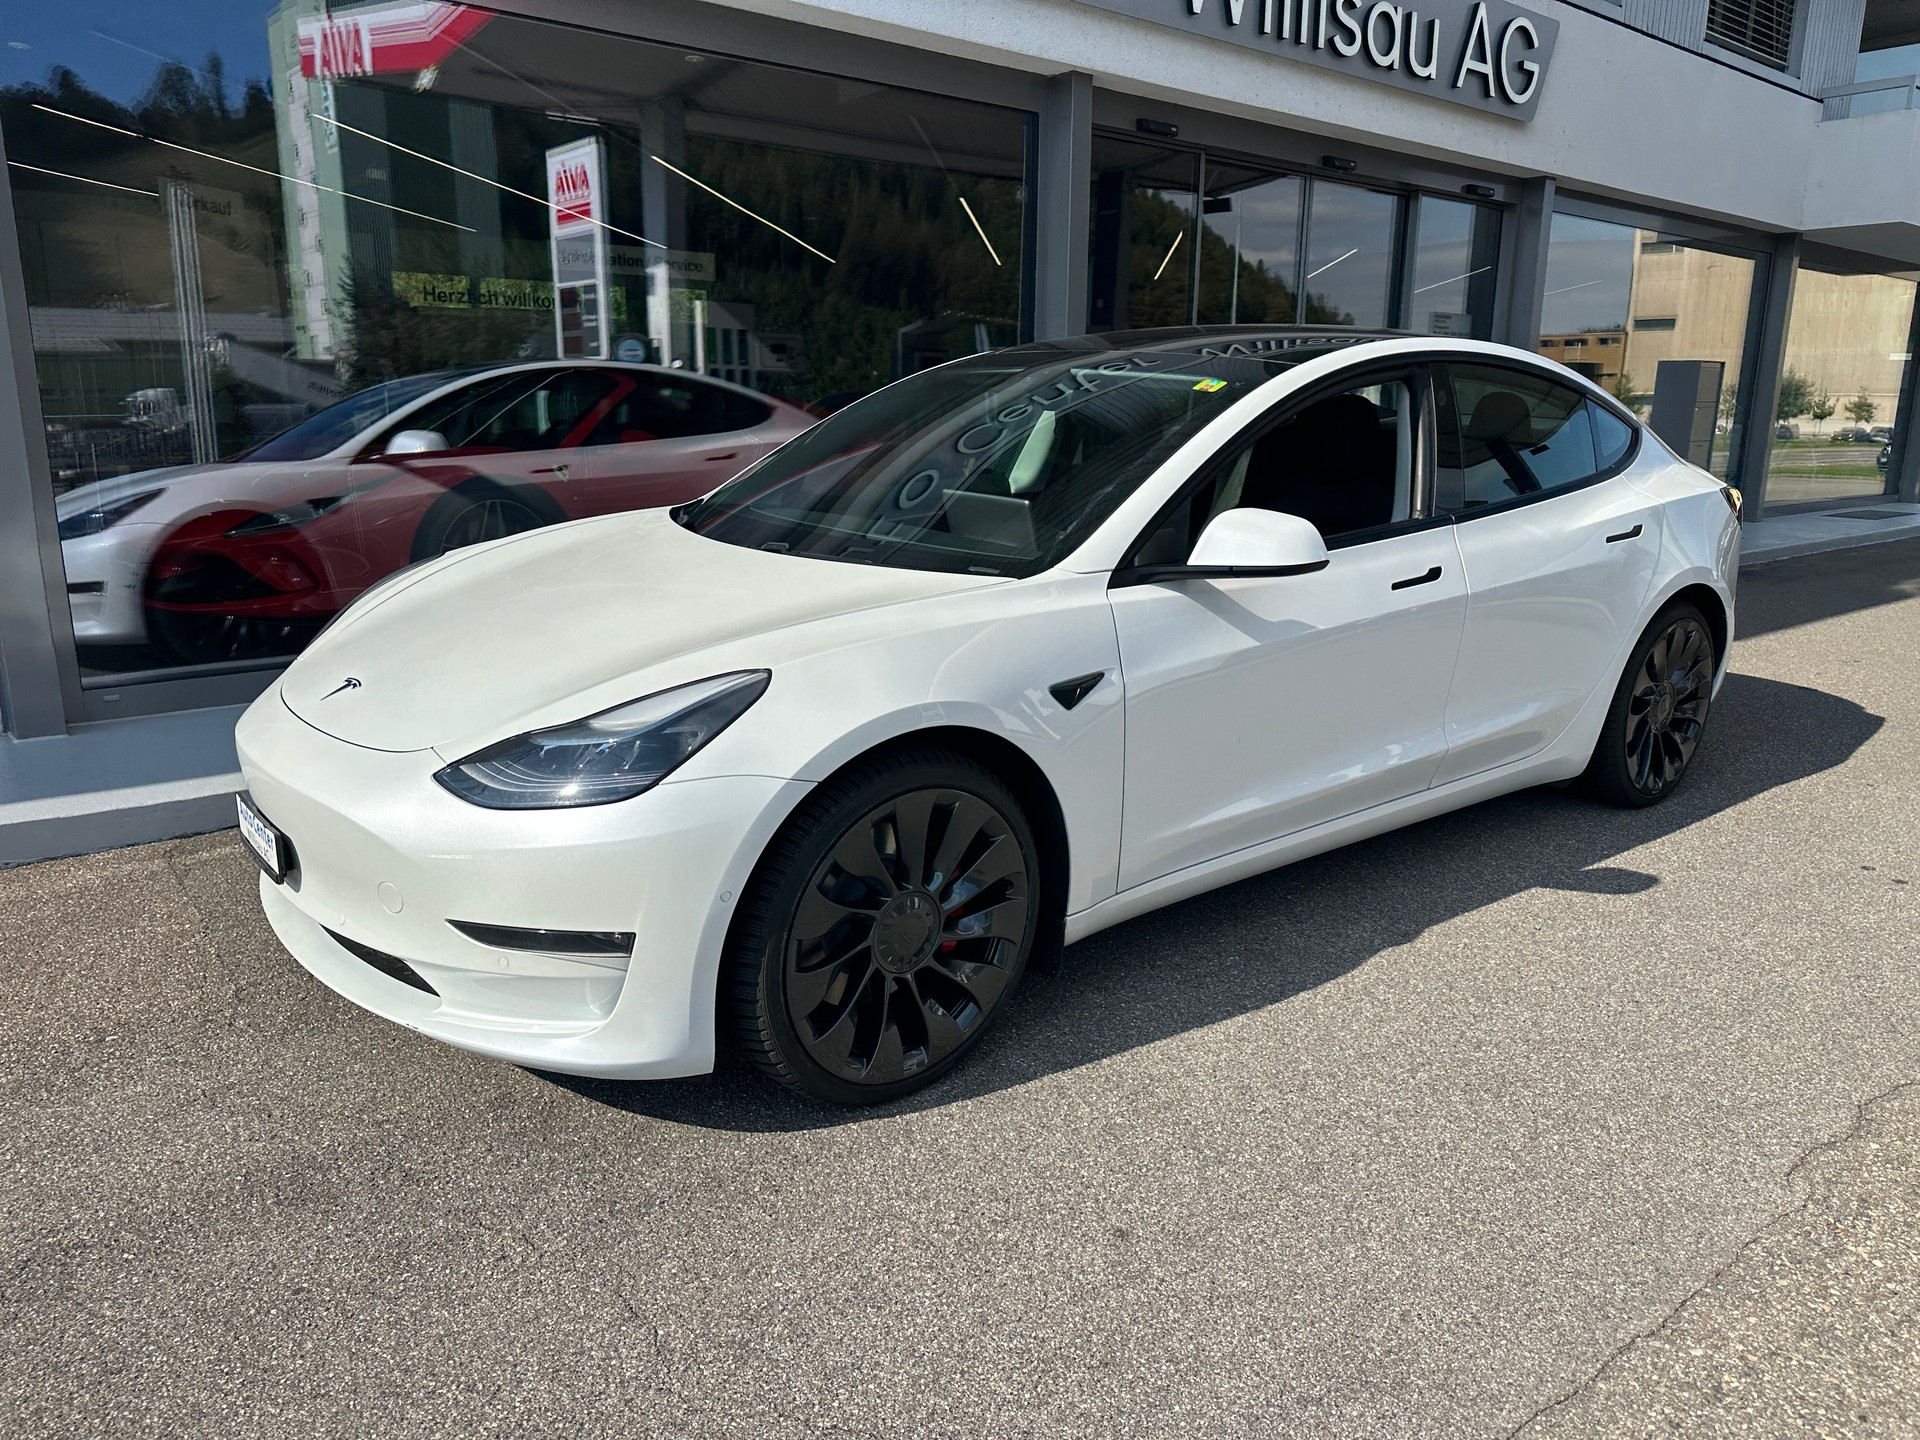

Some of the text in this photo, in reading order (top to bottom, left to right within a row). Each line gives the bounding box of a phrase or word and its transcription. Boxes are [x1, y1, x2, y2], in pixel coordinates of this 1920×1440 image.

[1187, 0, 1540, 104] isau AG
[655, 256, 704, 272] Srvice
[423, 285, 499, 306] Herzlch
